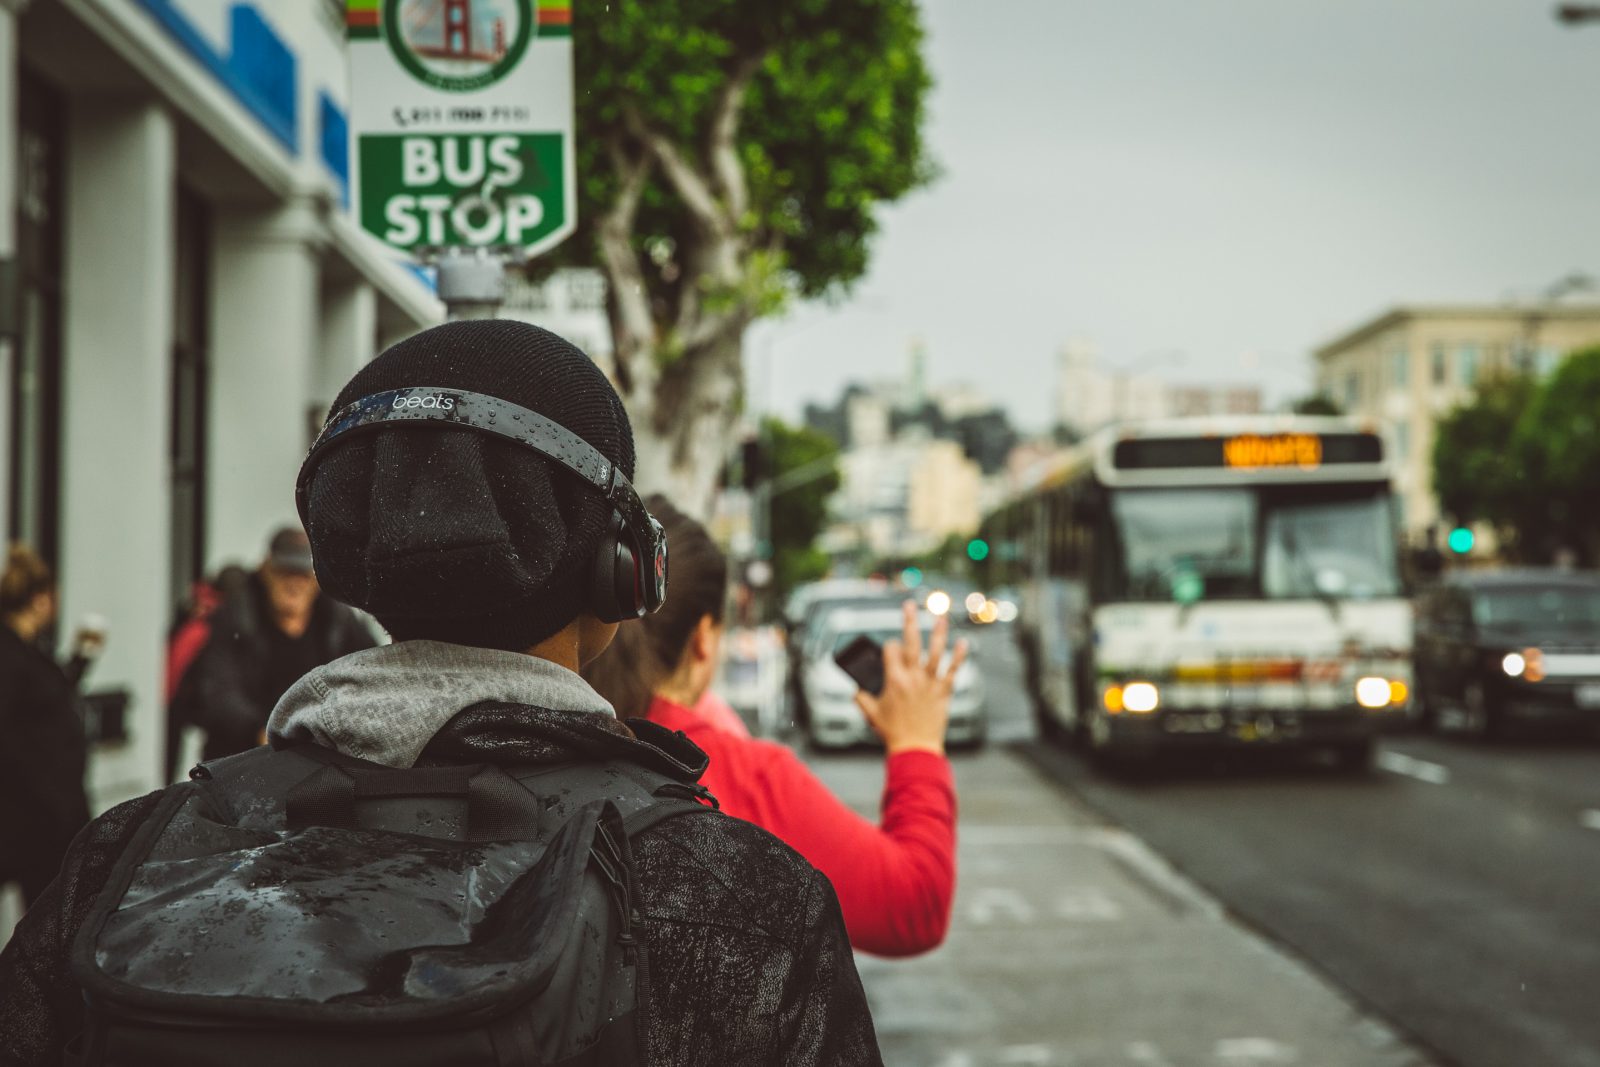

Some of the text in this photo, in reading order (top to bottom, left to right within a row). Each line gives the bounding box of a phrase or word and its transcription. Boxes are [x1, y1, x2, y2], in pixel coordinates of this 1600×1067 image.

[402, 136, 524, 187] BUS
[384, 194, 544, 245] STOP
[392, 394, 454, 410] beats
